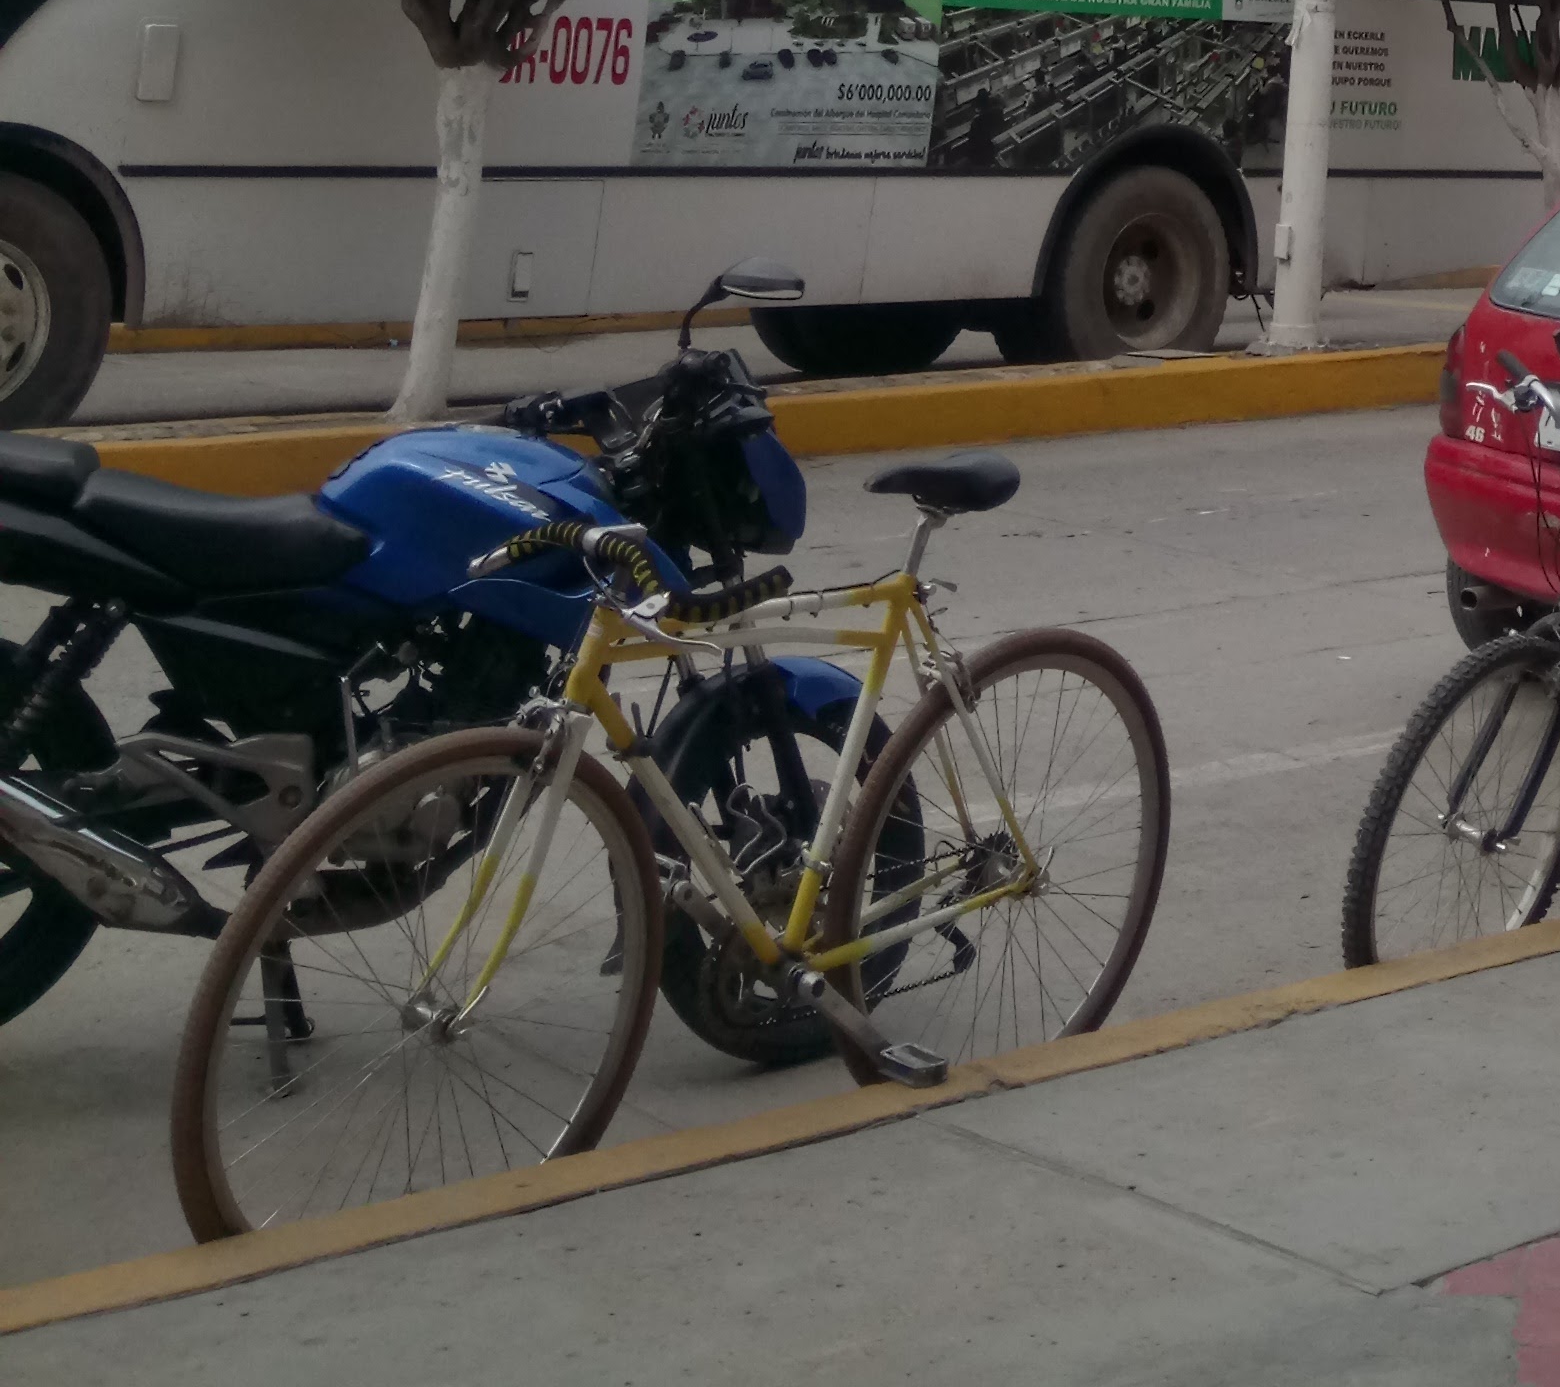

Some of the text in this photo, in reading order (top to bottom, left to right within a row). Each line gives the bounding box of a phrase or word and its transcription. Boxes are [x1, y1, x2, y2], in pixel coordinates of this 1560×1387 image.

[1347, 30, 1386, 42] ECKERLE
[1341, 45, 1389, 57] QUEREMOS
[1345, 60, 1386, 72] NUESTRO
[1357, 77, 1392, 88] PORQUE
[1340, 100, 1398, 116] FUTURO
[705, 101, 749, 134] juntos
[1465, 425, 1485, 443] 46
